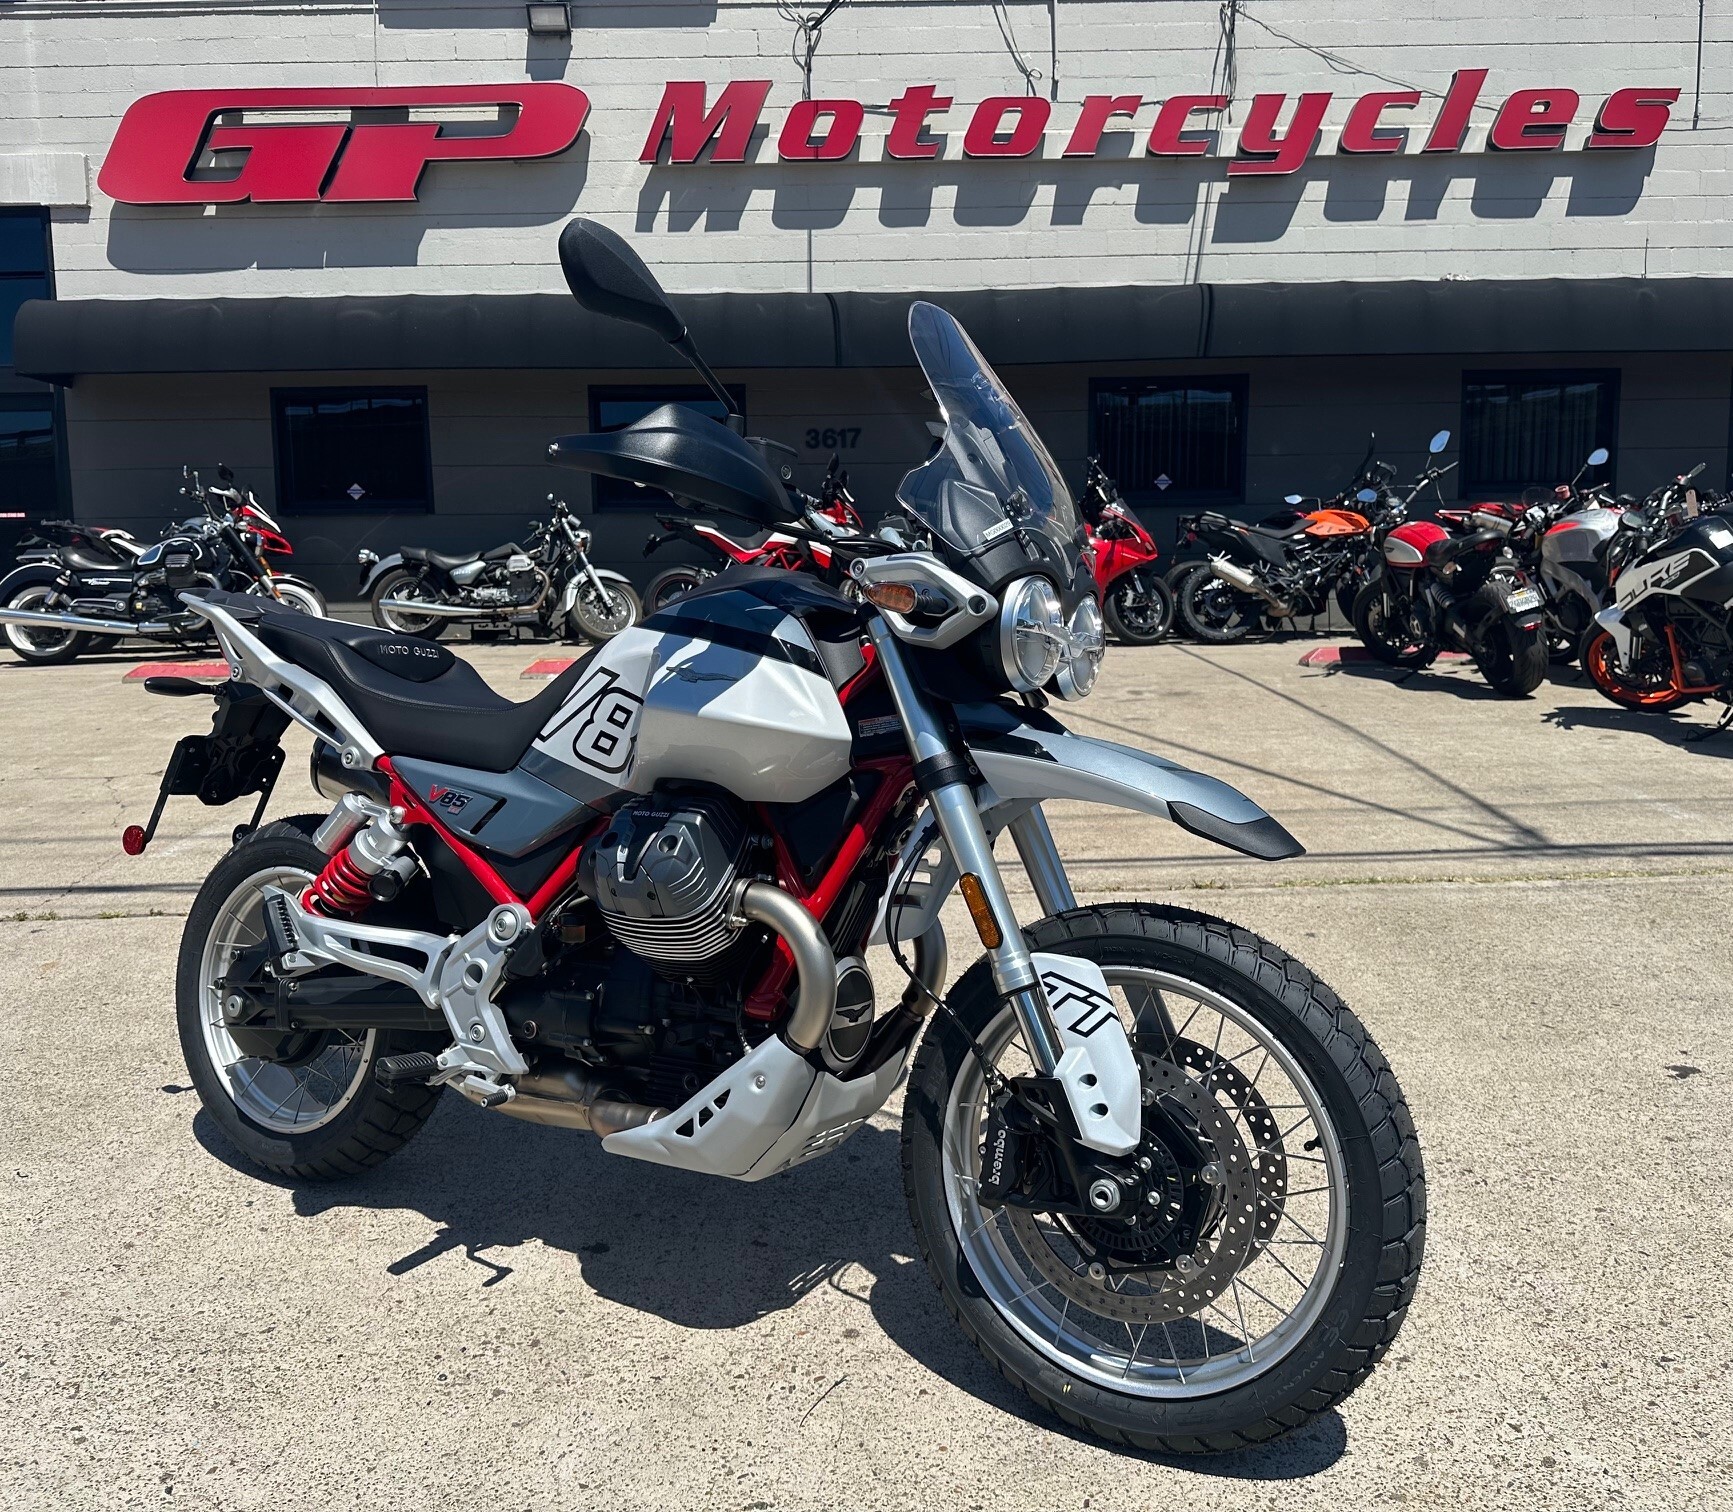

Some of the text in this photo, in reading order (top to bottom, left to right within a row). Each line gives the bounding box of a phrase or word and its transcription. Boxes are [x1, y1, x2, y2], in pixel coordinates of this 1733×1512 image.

[97, 68, 1682, 204] GP Motorcycles
[805, 428, 862, 449] 3617
[377, 644, 440, 659] MOTO GUZZI
[538, 666, 644, 778] V8
[429, 784, 474, 808] V85
[988, 1129, 1007, 1186] brembo
